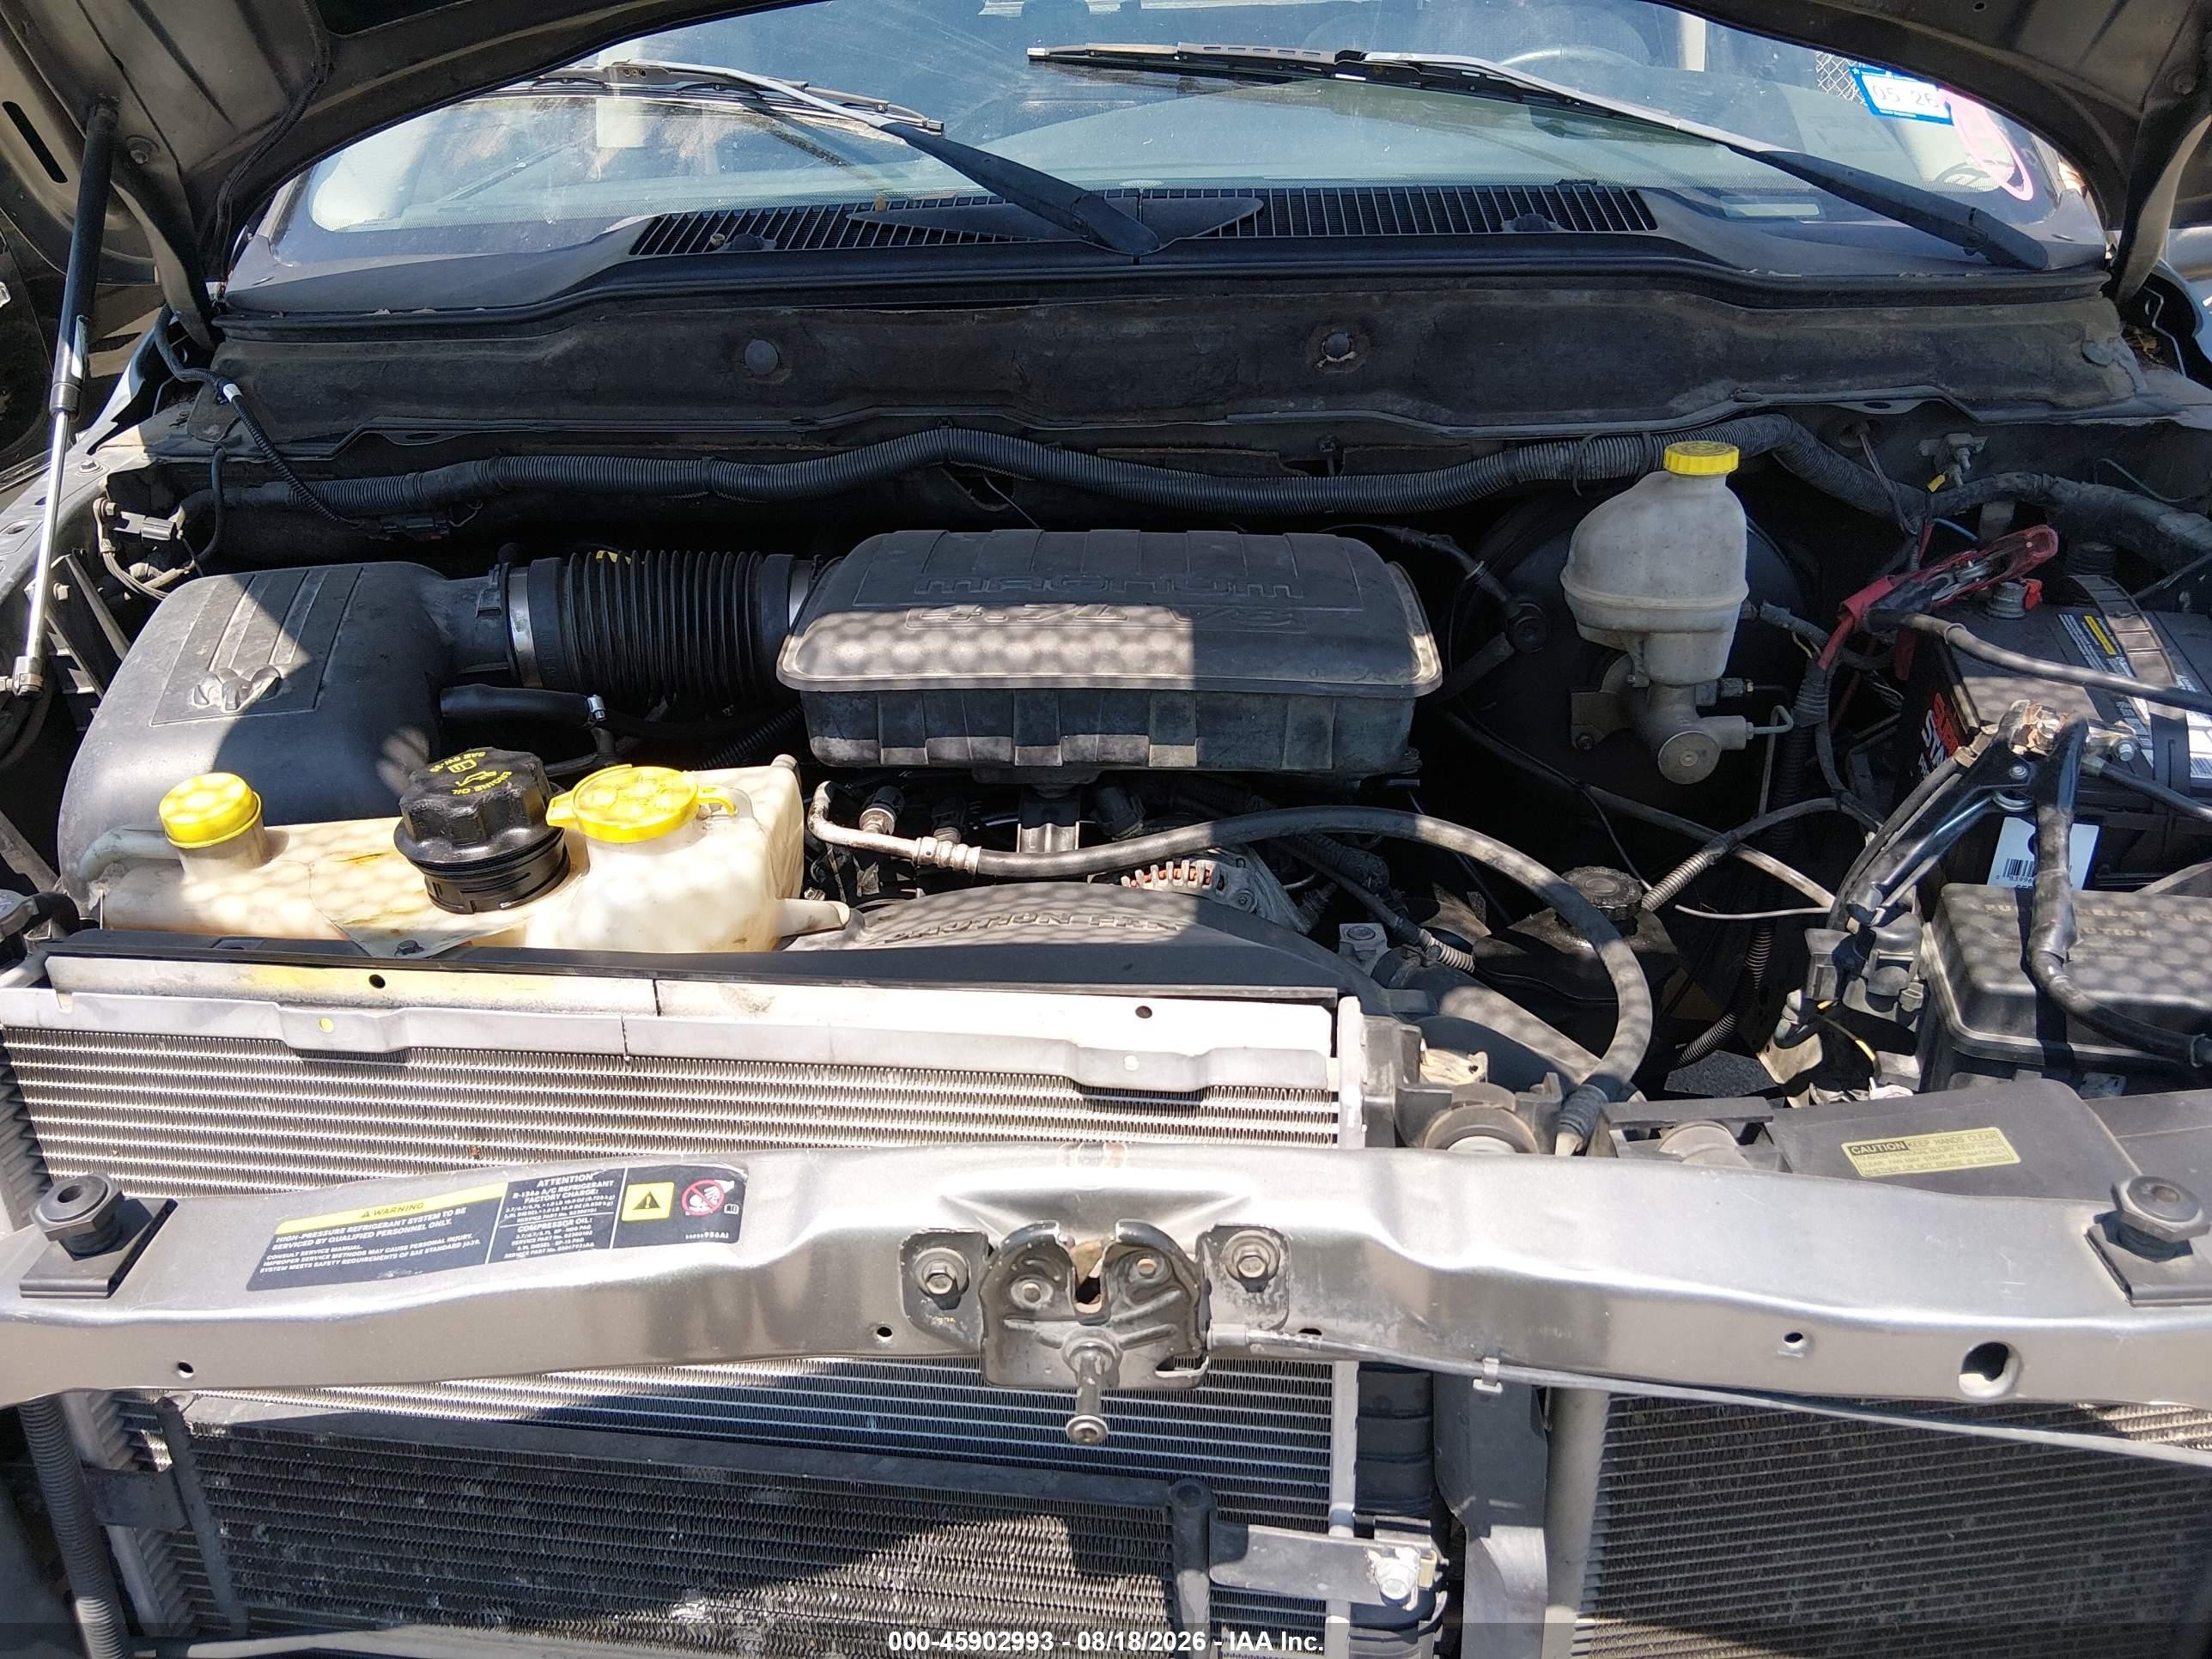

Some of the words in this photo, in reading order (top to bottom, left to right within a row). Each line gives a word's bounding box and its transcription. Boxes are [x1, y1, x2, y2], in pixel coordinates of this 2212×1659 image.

[1872, 84, 1900, 103] 05
[464, 751, 487, 760] SAE
[473, 771, 513, 792] ENGINE
[1089, 915, 1180, 932] FAN
[1850, 1141, 1905, 1154] CAUTION
[1907, 1139, 1929, 1148] KEEP
[1935, 1136, 1964, 1146] HANDS
[1968, 1133, 1999, 1142] CLEAR
[536, 1173, 593, 1188] ATTENTION
[557, 1181, 615, 1193] REFRIGERANT
[524, 1194, 561, 1204] FACTORY
[562, 1188, 599, 1199] CHARGE:
[374, 1202, 424, 1216] WARNING
[276, 1227, 346, 1243] HIGH-PRESSURE
[346, 1219, 408, 1233] REFRIGERANT
[407, 1212, 441, 1224] SYSTEM
[442, 1209, 454, 1218] TO
[454, 1206, 467, 1216] BE
[517, 1219, 574, 1233] COMPRESSOR
[271, 1240, 313, 1251] SERVICED
[328, 1231, 375, 1243] QUALIFIED
[375, 1224, 427, 1237] PERSONNEL
[428, 1218, 453, 1229] ONLY.
[259, 1265, 289, 1273] SYSTEM
[313, 1260, 341, 1268] SAFETY
[341, 1254, 398, 1265] REQUIREMENTS
[424, 1243, 462, 1255] STANDARD
[263, 1258, 301, 1267] IMPROPER
[331, 1250, 367, 1259] METHODS
[385, 1245, 409, 1254] CAUSE
[409, 1239, 446, 1249] PERSONAL
[447, 1233, 473, 1243] INJURY.
[266, 1252, 300, 1261] CONSULT
[300, 1248, 331, 1257] SERVICE
[331, 1244, 363, 1253] MANUAL.
